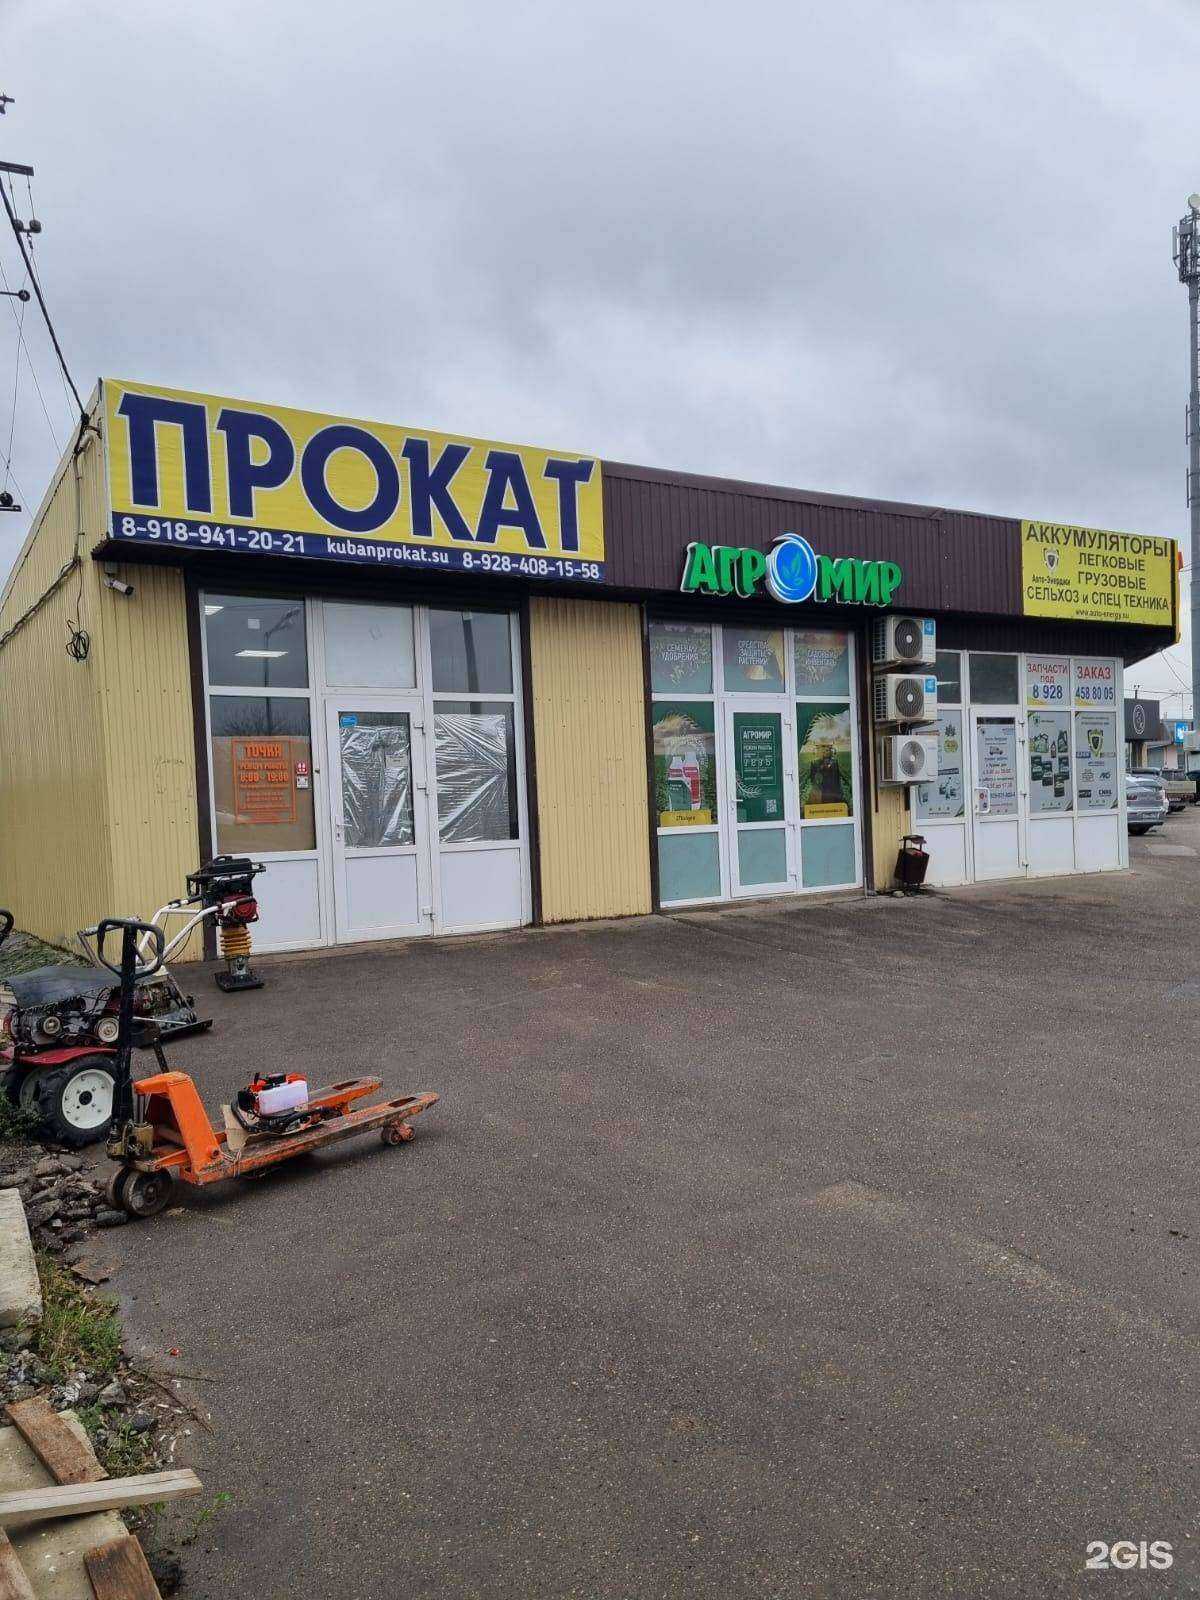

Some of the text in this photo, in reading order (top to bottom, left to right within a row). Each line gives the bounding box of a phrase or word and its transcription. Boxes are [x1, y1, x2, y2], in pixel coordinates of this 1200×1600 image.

[117, 392, 595, 553] ПРОКАТ
[120, 516, 600, 580] 8-918-941-20-21 kubanprokat.su 8-928-408-15-58
[1026, 523, 1169, 558] АККУМУЛЯТОРЫ
[1078, 552, 1146, 572] ЛЕГКОВЫЕ
[1078, 571, 1147, 591] ГРУЗОВЫЕ
[1026, 586, 1080, 604] СЕЛЬХОЗ
[1091, 591, 1121, 609] СПЕЦ
[1123, 594, 1169, 611] ТЕХНИКА
[1027, 663, 1067, 674] ЗАПЧАСТИ
[1077, 666, 1111, 680] ЗАКАЗ
[1033, 686, 1039, 699] 8
[1042, 685, 1063, 700] 928
[1075, 686, 1090, 699] 458
[743, 730, 772, 740] АГРОМИР
